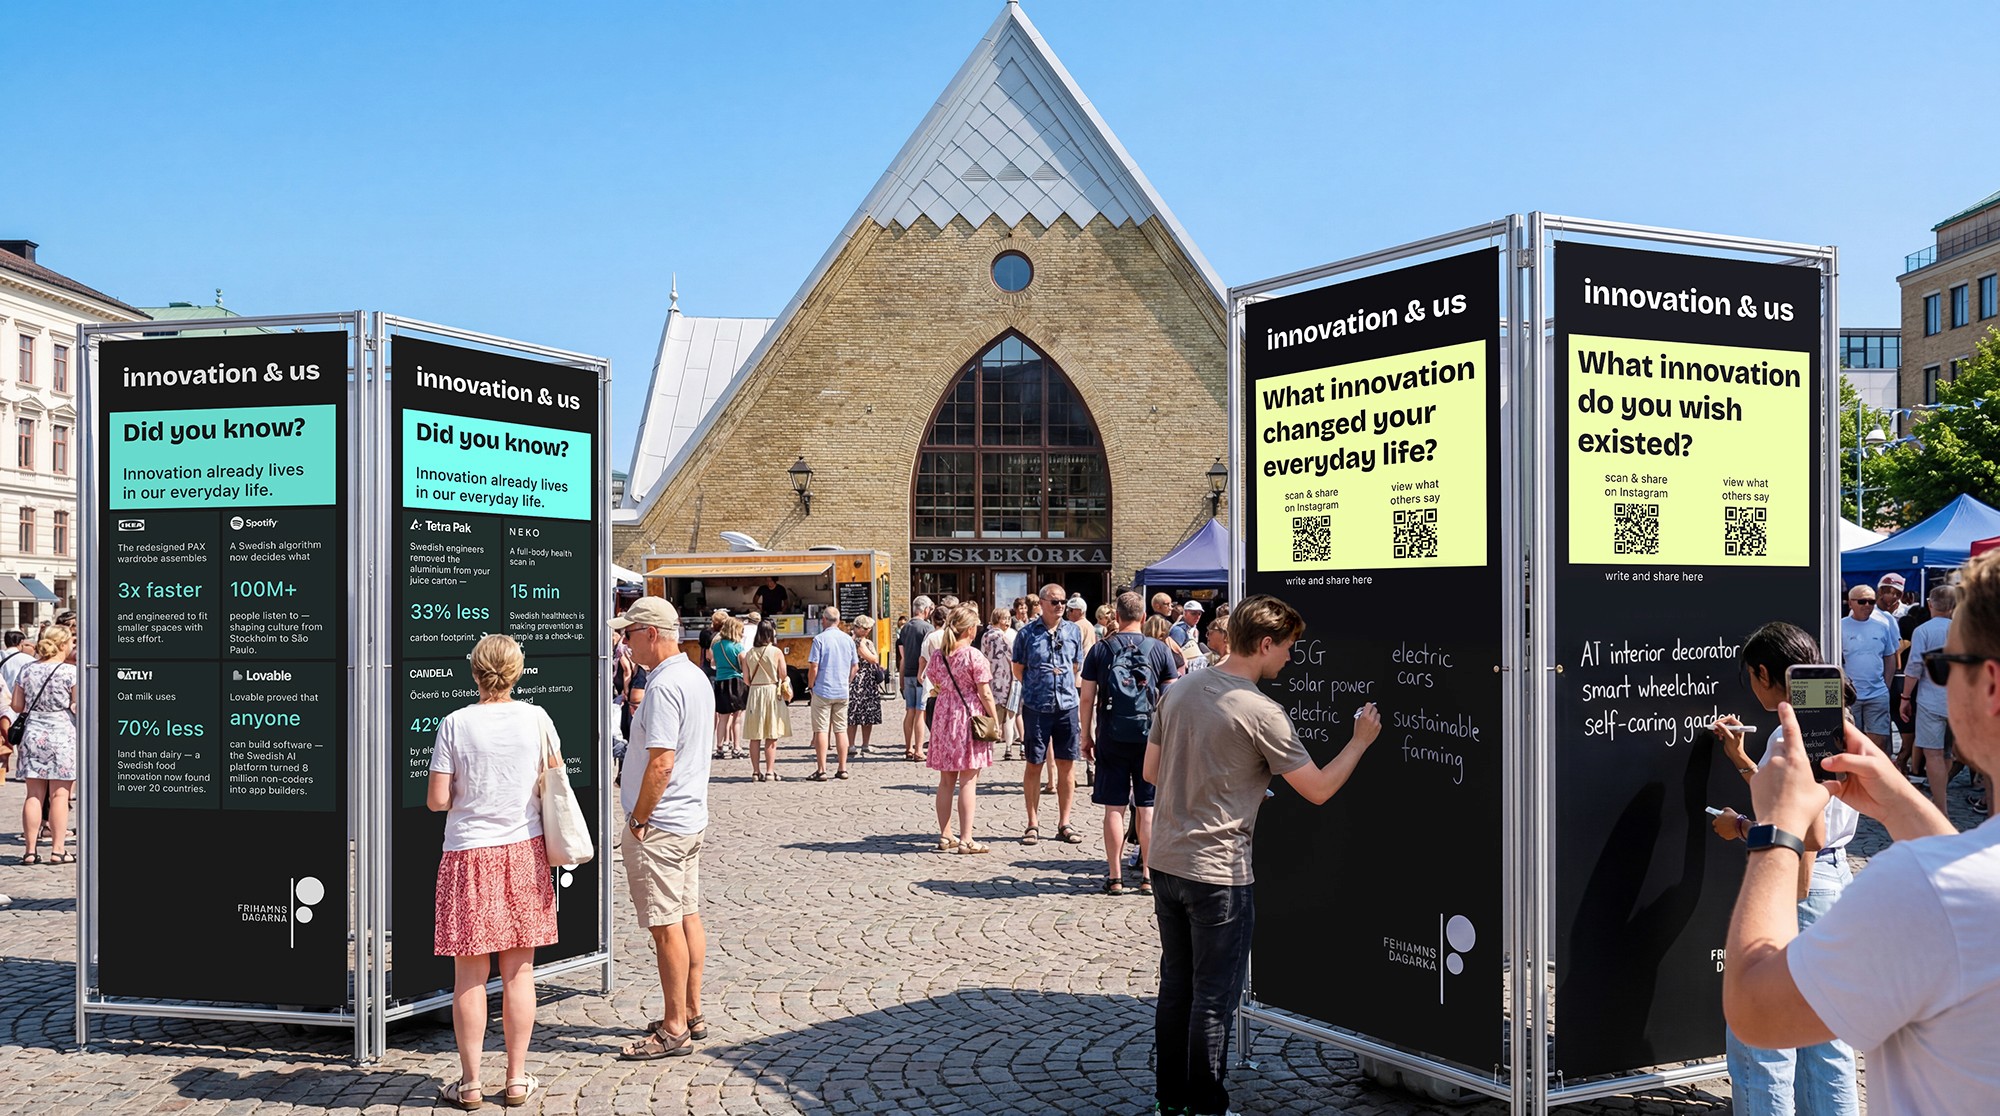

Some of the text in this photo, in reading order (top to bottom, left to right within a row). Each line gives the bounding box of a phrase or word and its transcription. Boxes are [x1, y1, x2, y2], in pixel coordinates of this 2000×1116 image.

[1585, 278, 1794, 321] innovation & us
[1267, 294, 1467, 350] innovation & us
[124, 363, 320, 387] innovation & us
[1578, 350, 1800, 388] What innovation
[417, 366, 580, 410] innovation & us
[1263, 360, 1475, 410] What innovation
[1578, 388, 1742, 421] do you wish
[1263, 405, 1436, 444] changed your
[124, 418, 305, 445] Did you know?
[417, 422, 569, 457] Did you know?
[1578, 428, 1693, 457] existed?
[1264, 439, 1437, 477] everyday life?
[124, 463, 304, 480] Innovation already lives
[1605, 473, 1668, 484] scan & share
[1723, 477, 1768, 488] view what
[123, 483, 273, 500] in our everyday life.
[1391, 480, 1439, 491] view what
[1285, 489, 1339, 500] scan & share
[1604, 487, 1668, 500] on Instagram
[1722, 491, 1769, 503] others say
[1390, 495, 1440, 505] others say
[1285, 502, 1339, 513] on Instagram
[120, 521, 143, 529] IKEA
[246, 518, 278, 528] Spotify
[425, 520, 471, 533] Tetra Pak
[509, 528, 539, 537] NEKO
[118, 544, 134, 552] The
[136, 543, 185, 553] redesigned
[230, 541, 321, 551] A Swedish algorithm
[410, 542, 484, 554] Swedish engineers
[117, 554, 207, 563] wardrobe assembles
[250, 552, 286, 561] decides
[288, 552, 310, 560] what
[517, 547, 549, 558] full-body
[551, 549, 572, 557] health
[410, 555, 460, 563] removed the
[529, 558, 535, 566] in
[410, 565, 490, 576] aluminium from your
[1605, 571, 1703, 581] write and share here
[410, 576, 429, 585] juice
[1286, 575, 1372, 585] write and share here
[118, 582, 202, 598] 3x faster
[231, 581, 297, 597] 100M+
[510, 584, 559, 599] 15 min
[411, 604, 489, 619] 33% less
[410, 633, 476, 642] carbon footprint.
[1294, 639, 1326, 665] 5G
[1392, 642, 1453, 668] electric
[1610, 640, 1665, 664] interior
[1672, 637, 1740, 661] decorator
[246, 670, 292, 681] Lovable
[410, 668, 453, 678] CANDELA
[1397, 671, 1433, 688] cars
[1289, 672, 1375, 702] solar power
[1583, 673, 1719, 702] smart wheelchair
[117, 692, 133, 700] Oat
[136, 692, 153, 700] milk
[230, 693, 318, 703] Lovable proved that
[410, 690, 439, 700] Öckerö
[1289, 700, 1340, 724] electric
[230, 713, 300, 729] anyone
[1394, 708, 1480, 742] sustainable
[1584, 705, 1740, 747] self-caring gard
[118, 720, 204, 736] 70% less
[1298, 727, 1329, 742] cars
[118, 750, 136, 758] land
[138, 750, 157, 758] than
[160, 750, 182, 760] dairy
[1402, 734, 1463, 785] farming
[117, 761, 175, 770] Swedish food
[118, 772, 162, 781] innovation
[185, 773, 210, 782] found
[118, 783, 125, 791] in
[149, 784, 160, 792] 20
[162, 784, 206, 793] countries.
[237, 904, 288, 914] FRIHAMNS
[242, 913, 287, 922] DAGARNA
